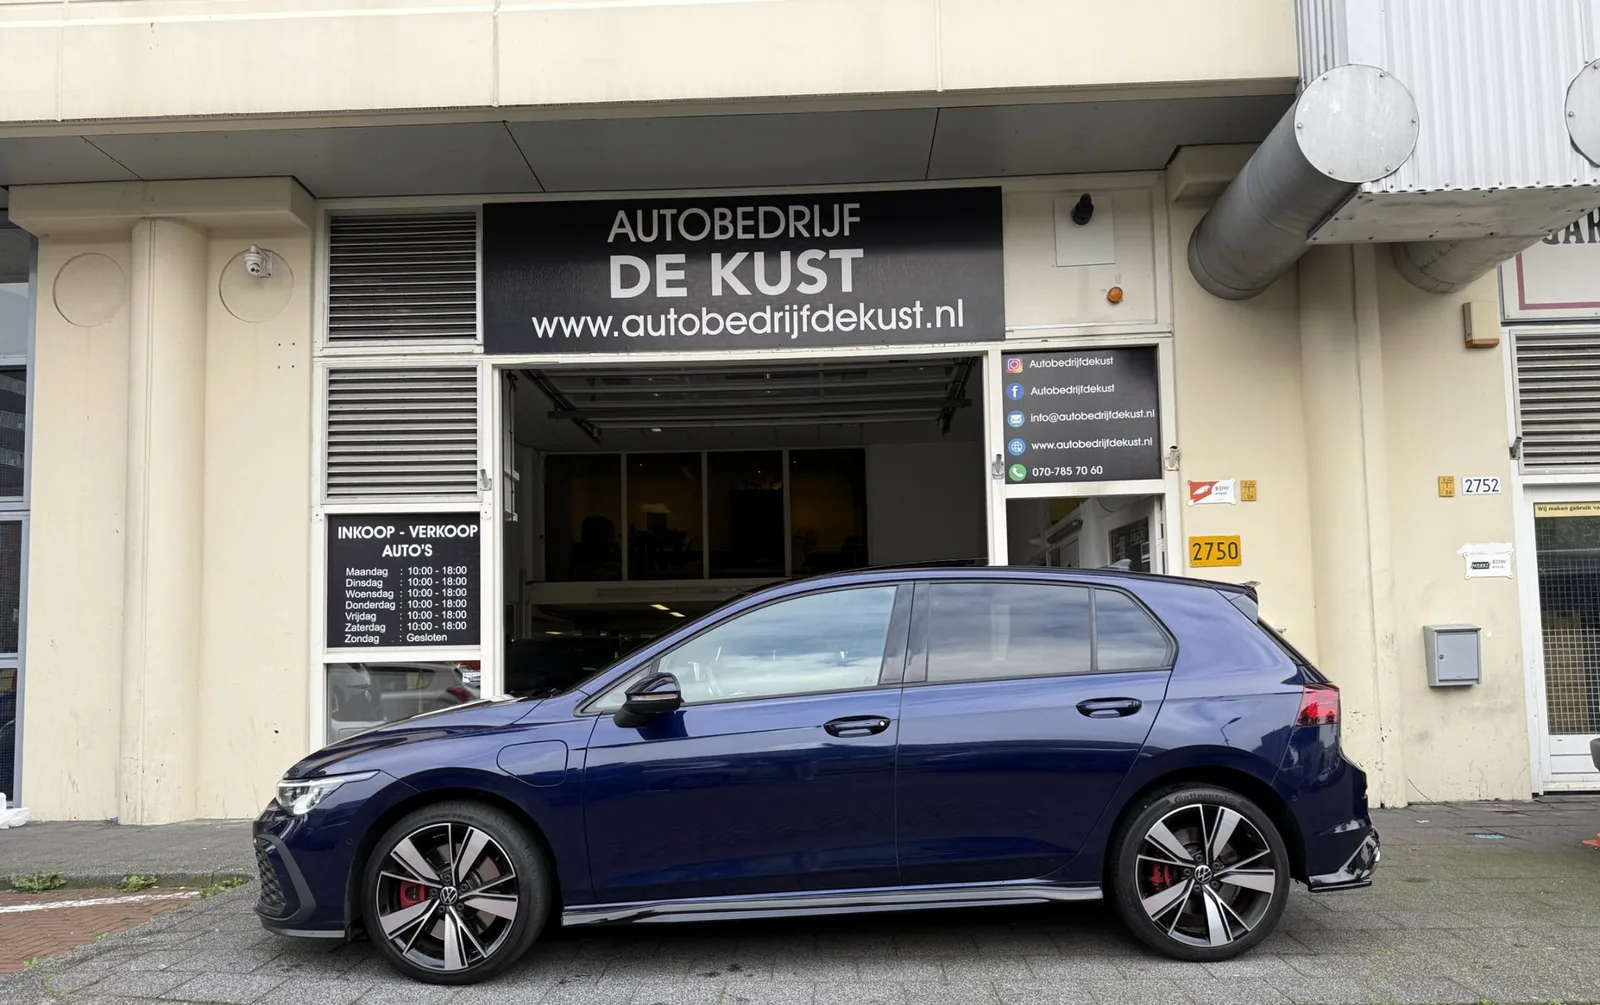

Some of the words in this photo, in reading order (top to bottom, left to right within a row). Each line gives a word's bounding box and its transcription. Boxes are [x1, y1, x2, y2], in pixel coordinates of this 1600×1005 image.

[607, 203, 861, 243] AUTOBEDRIJF
[610, 253, 688, 299] DE
[711, 248, 864, 297] KUST
[531, 298, 964, 340] www.autobedrijfdekust.nl
[1029, 356, 1114, 369] Autobedrijfdekust
[1030, 383, 1115, 396] Autobedrijfdekust
[1030, 408, 1155, 423] info@autobedrijfdekust.nl
[1031, 437, 1153, 451] www.autobedrijfdekust.nl
[1032, 466, 1073, 477] 070-785
[1075, 465, 1088, 476] 70
[1090, 465, 1104, 475] 60
[1465, 478, 1499, 493] 2752
[337, 525, 396, 539] INKOOP
[409, 524, 479, 538] VERKOOP
[381, 543, 433, 557] AUTO'S
[1192, 541, 1239, 561] 2750
[345, 567, 389, 577] Maandag
[408, 567, 433, 575] 10:00
[442, 566, 467, 574] 18:00
[345, 578, 383, 588] Dinsdag
[408, 578, 433, 586] 10:00
[442, 577, 467, 585] 18:00
[345, 590, 394, 599] Woensdag
[407, 589, 433, 597] 10:00
[442, 588, 467, 596] 18:00
[345, 601, 396, 610] Donderdag
[407, 600, 433, 608] 10:00
[442, 599, 467, 607] 18:00
[345, 612, 377, 622] Vrijdag
[407, 611, 432, 619] 10:00
[442, 610, 467, 618] 18:00
[345, 623, 386, 633] Zaterdag
[407, 622, 432, 630] 10:00
[442, 621, 467, 630] 18:00
[344, 634, 380, 644] Zondag
[406, 633, 448, 642] Gesloten
